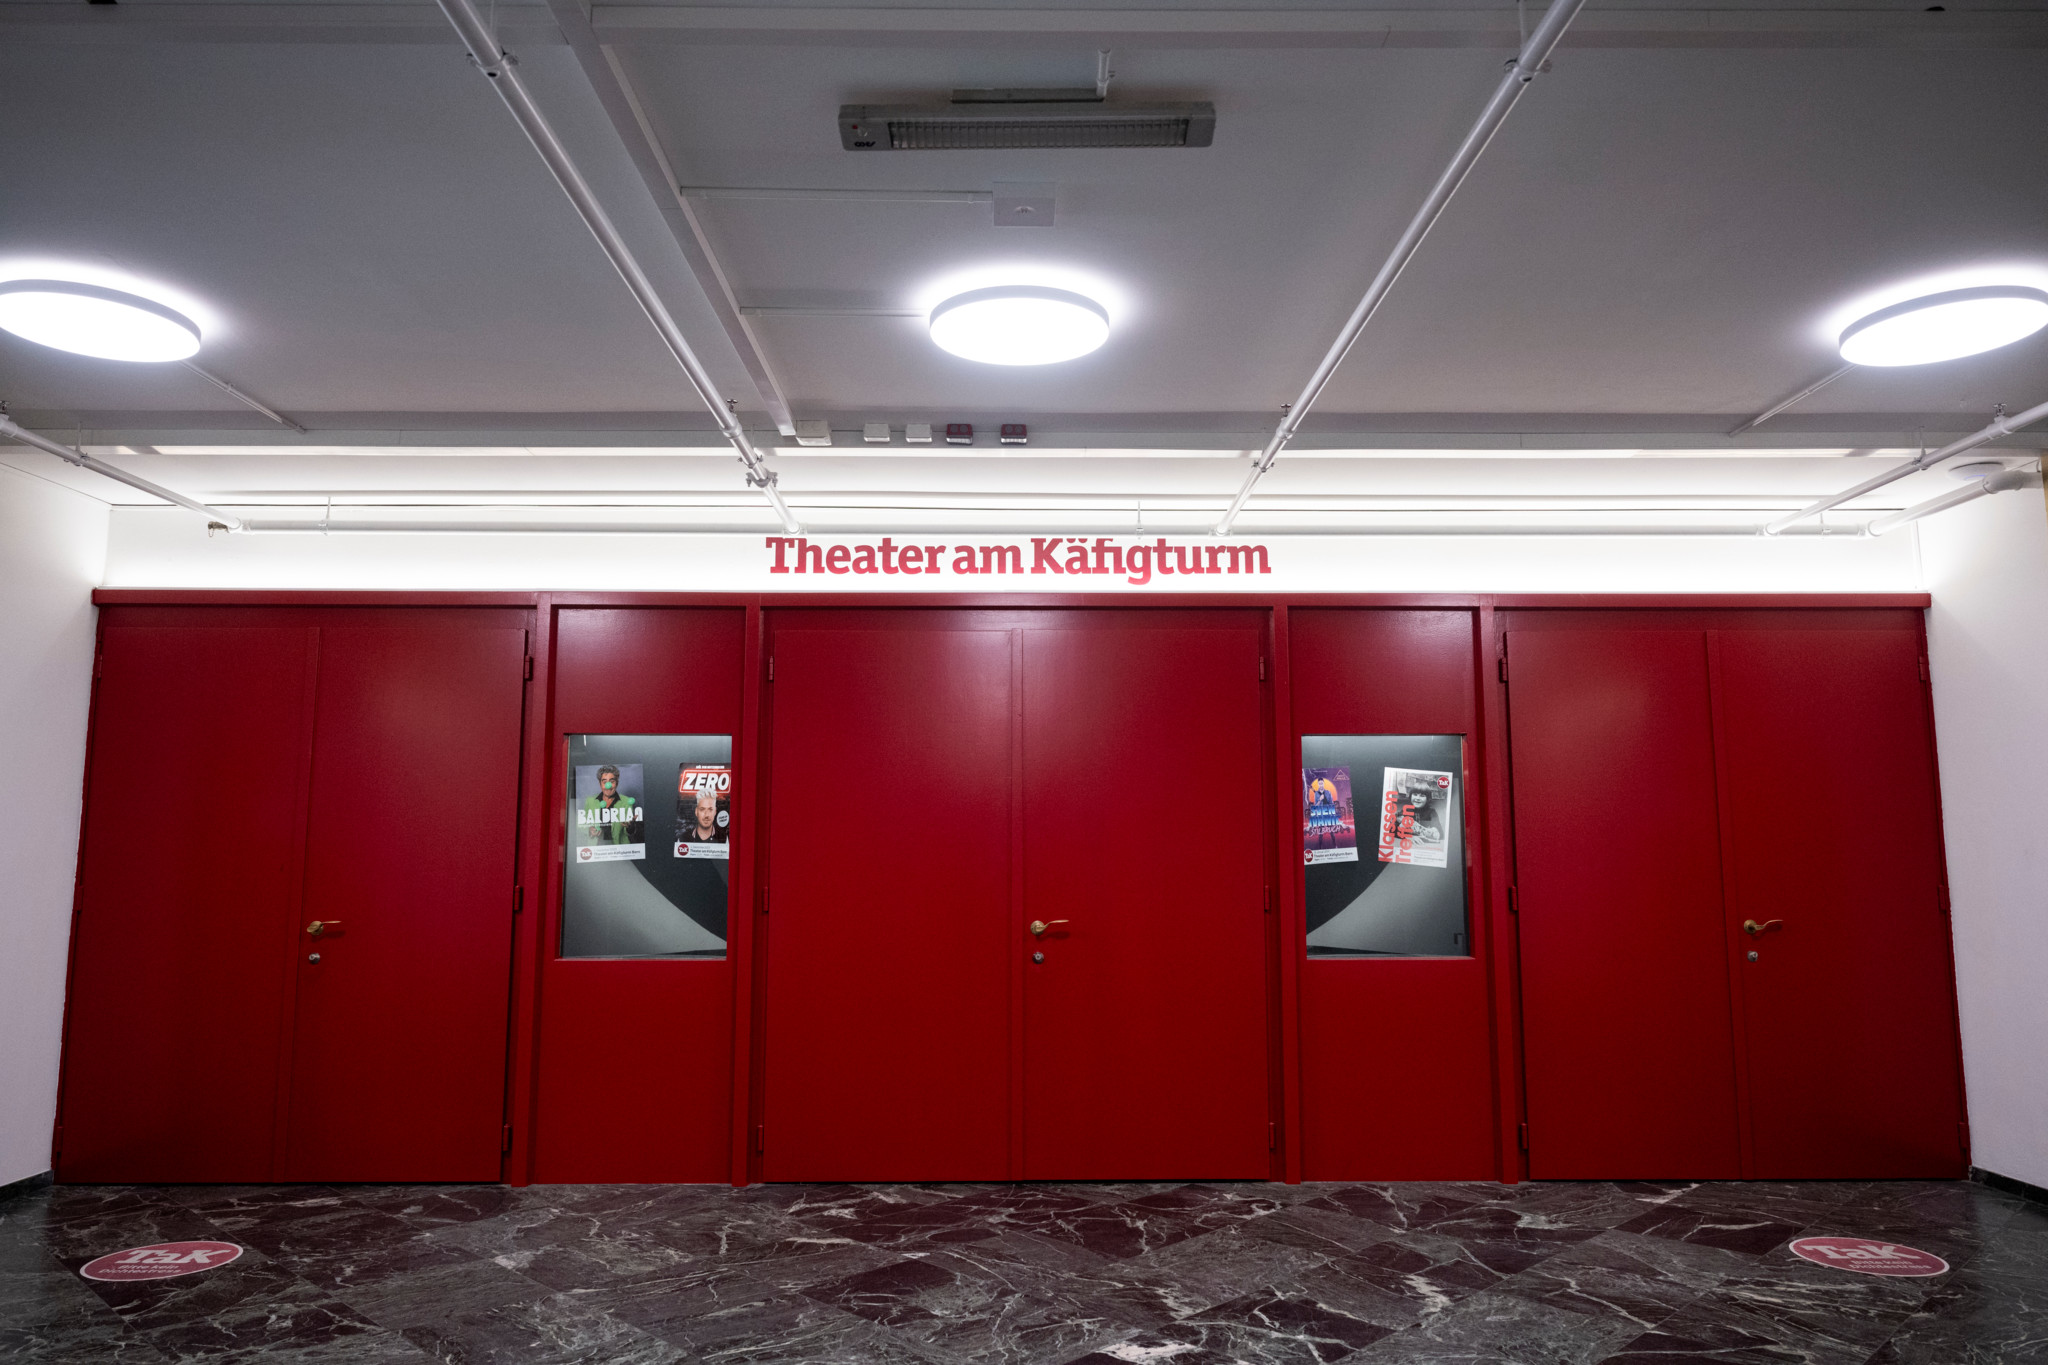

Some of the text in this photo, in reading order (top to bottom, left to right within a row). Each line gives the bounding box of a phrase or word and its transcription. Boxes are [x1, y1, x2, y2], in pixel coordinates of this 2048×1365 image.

[765, 536, 1272, 586] Theater am Käfigturm
[683, 773, 729, 790] ZERO
[577, 806, 644, 824] BALDRIAN
[1378, 791, 1399, 863] Klassen
[1395, 804, 1416, 863] Treffen
[114, 1249, 233, 1264] TaK
[1801, 1245, 1922, 1259] TaK
